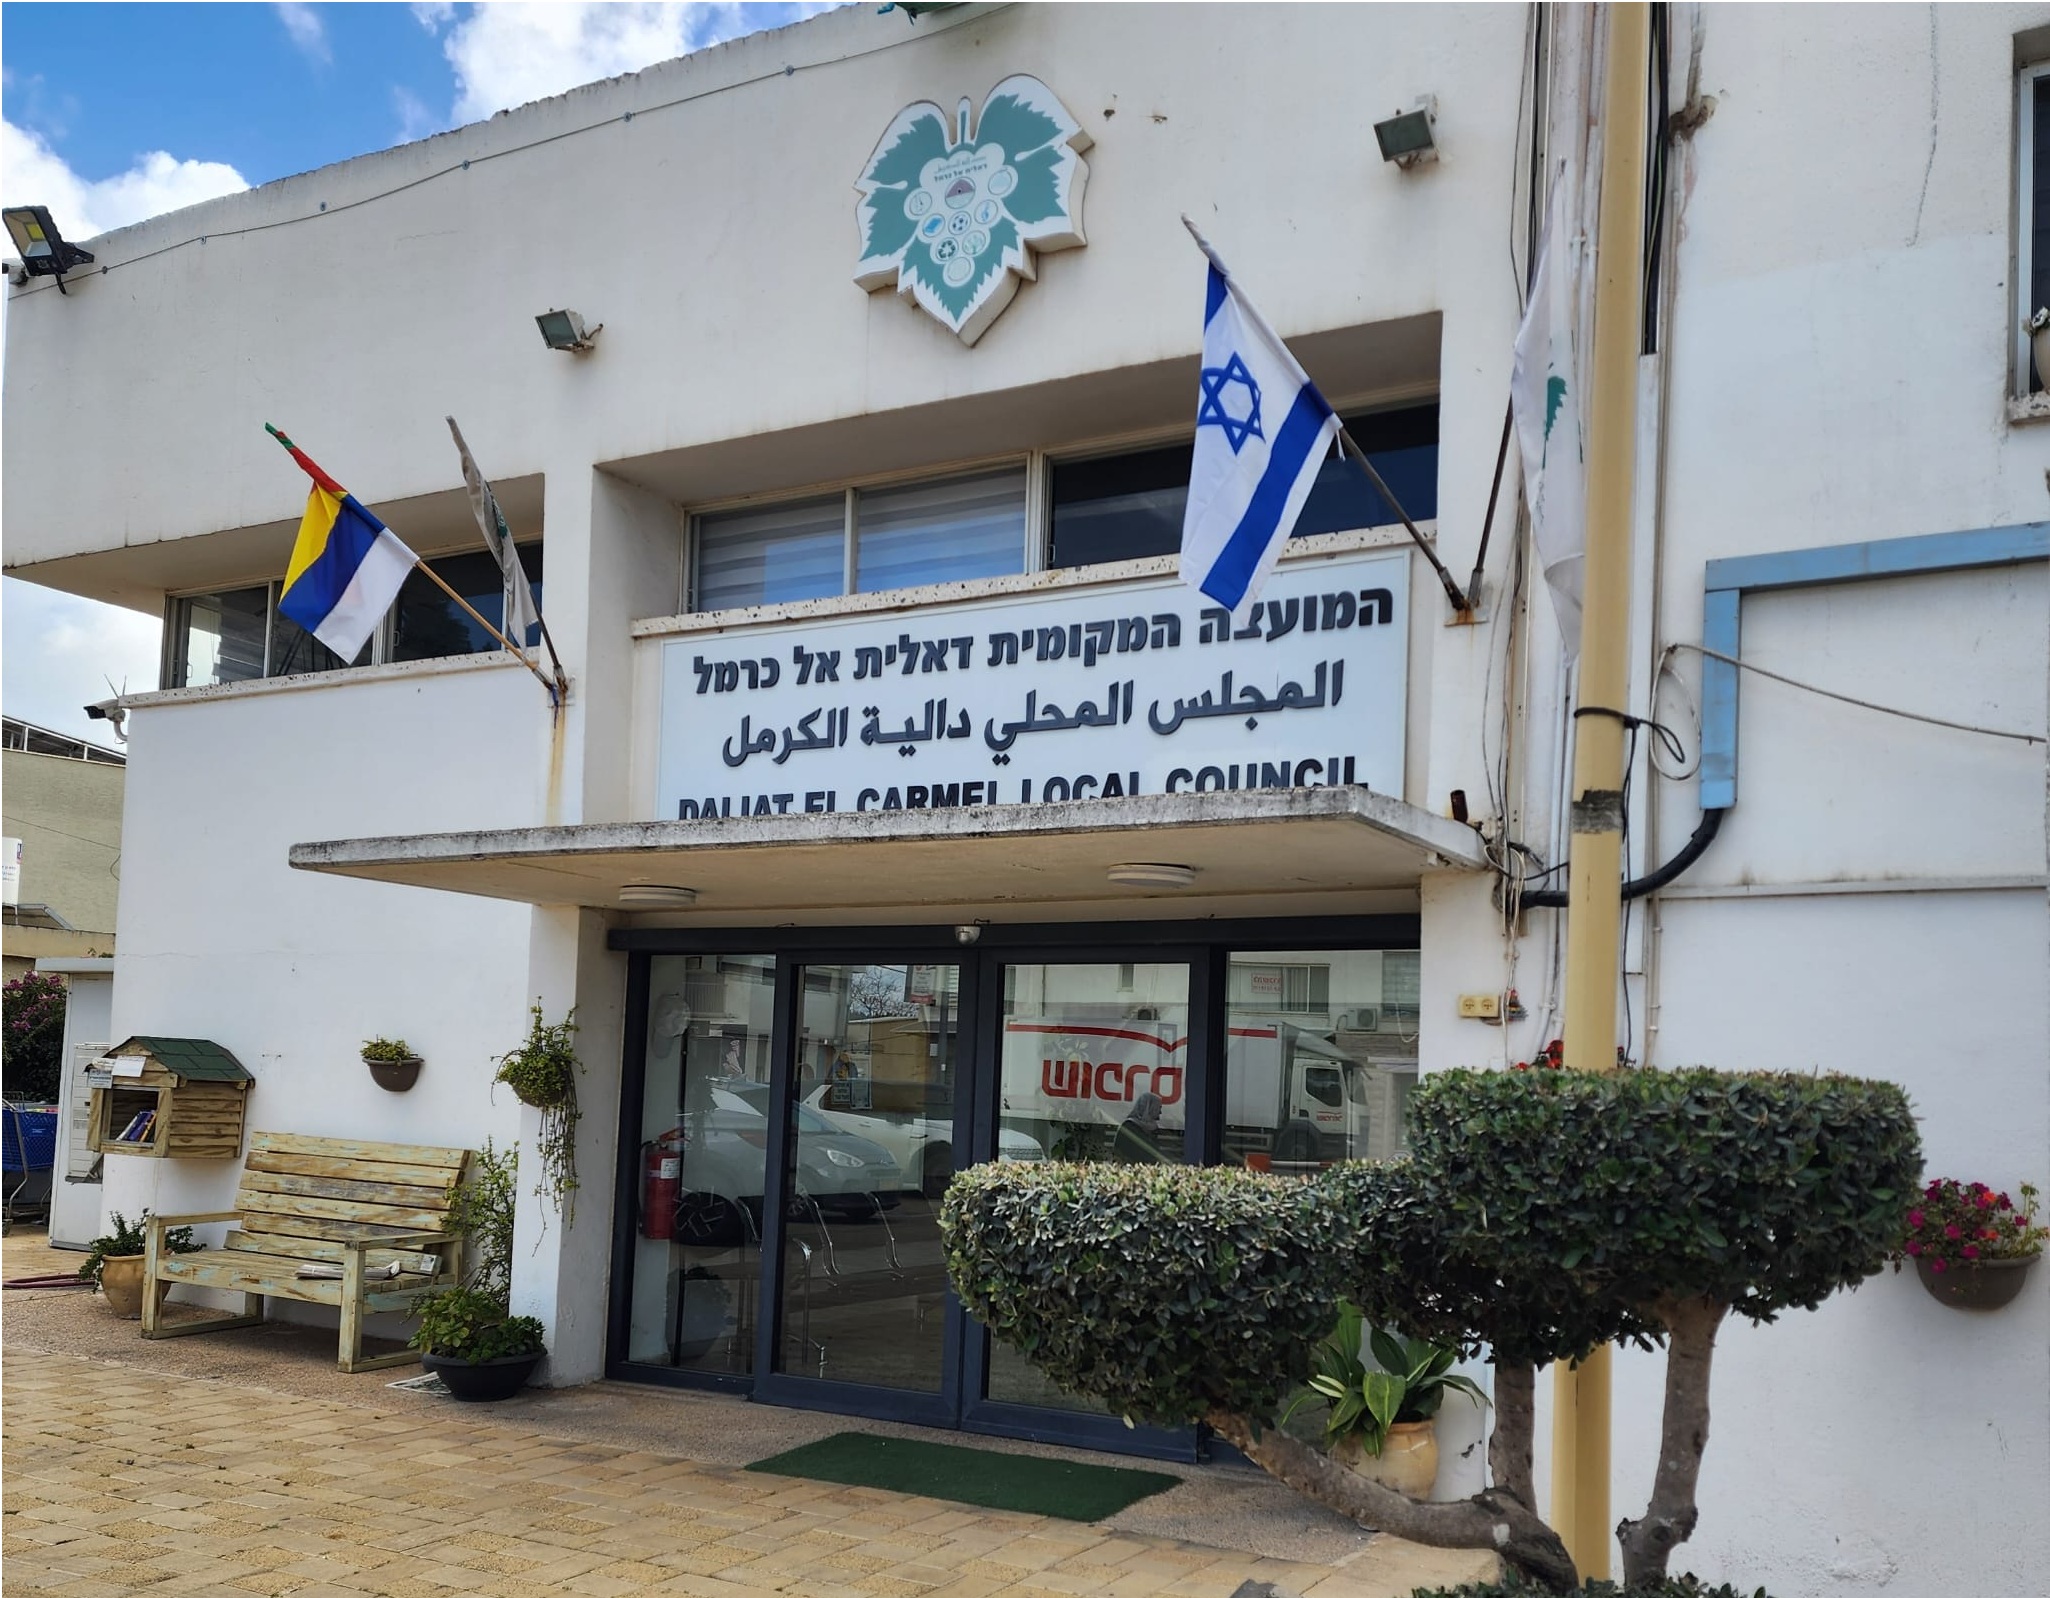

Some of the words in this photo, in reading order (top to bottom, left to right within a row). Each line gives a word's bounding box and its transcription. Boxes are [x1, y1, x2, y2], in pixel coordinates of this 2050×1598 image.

[987, 612, 1181, 667] המקומית
[1200, 588, 1393, 643] המועצה
[693, 656, 780, 694] כרמל
[793, 645, 840, 685] אל
[853, 634, 973, 680] דאלית
[984, 679, 1134, 767] المحلي
[1148, 659, 1344, 735] المجلس
[722, 706, 849, 767] الكرمل
[860, 698, 971, 757] دالية
[1165, 756, 1368, 794] COUNCIL
